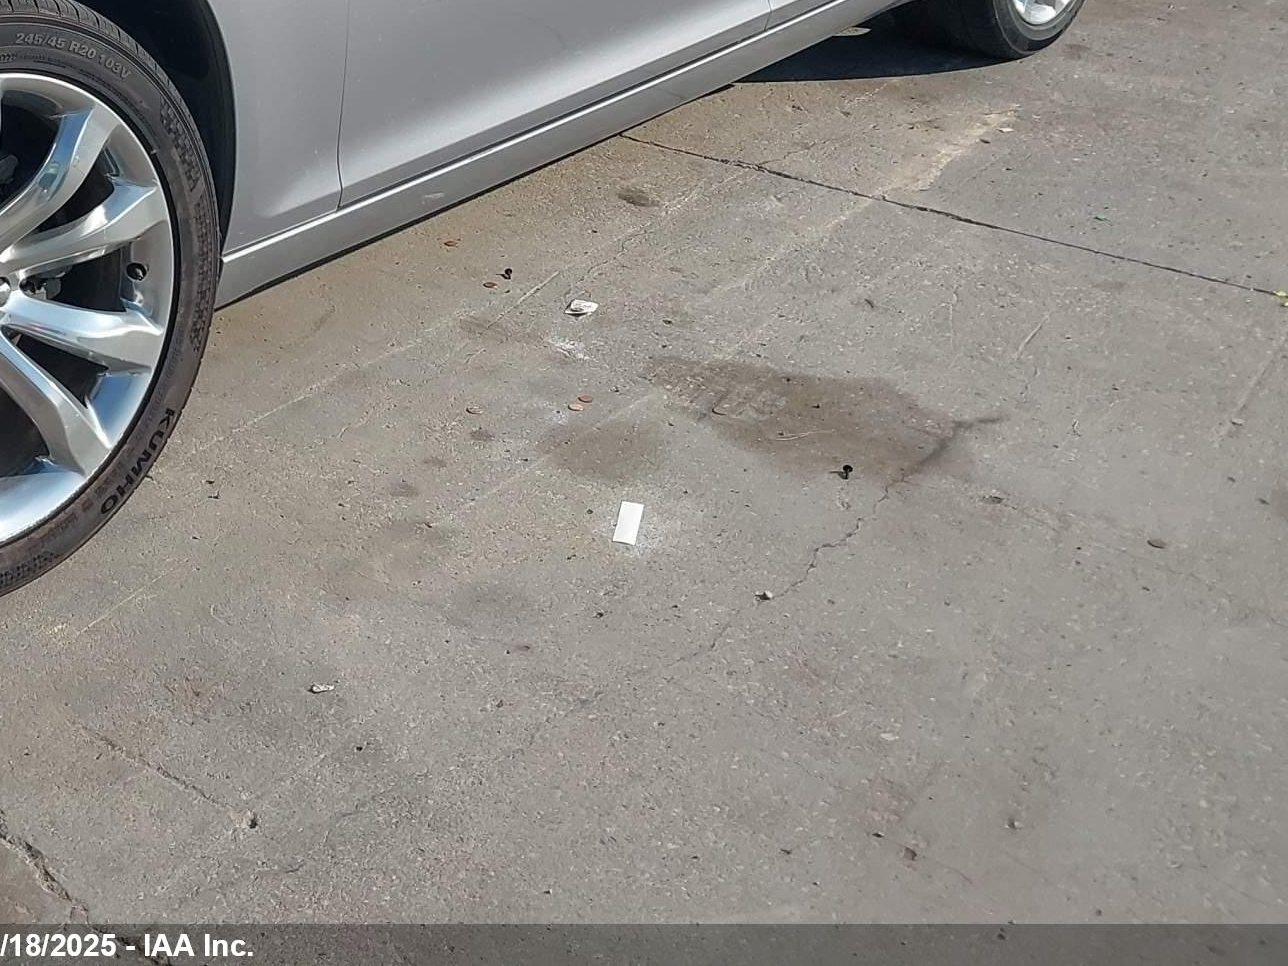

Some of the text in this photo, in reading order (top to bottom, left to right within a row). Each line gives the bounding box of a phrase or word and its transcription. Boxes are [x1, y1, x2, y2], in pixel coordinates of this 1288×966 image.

[15, 32, 132, 79] 245/45 R20 103V
[100, 407, 176, 515] KUMHO
